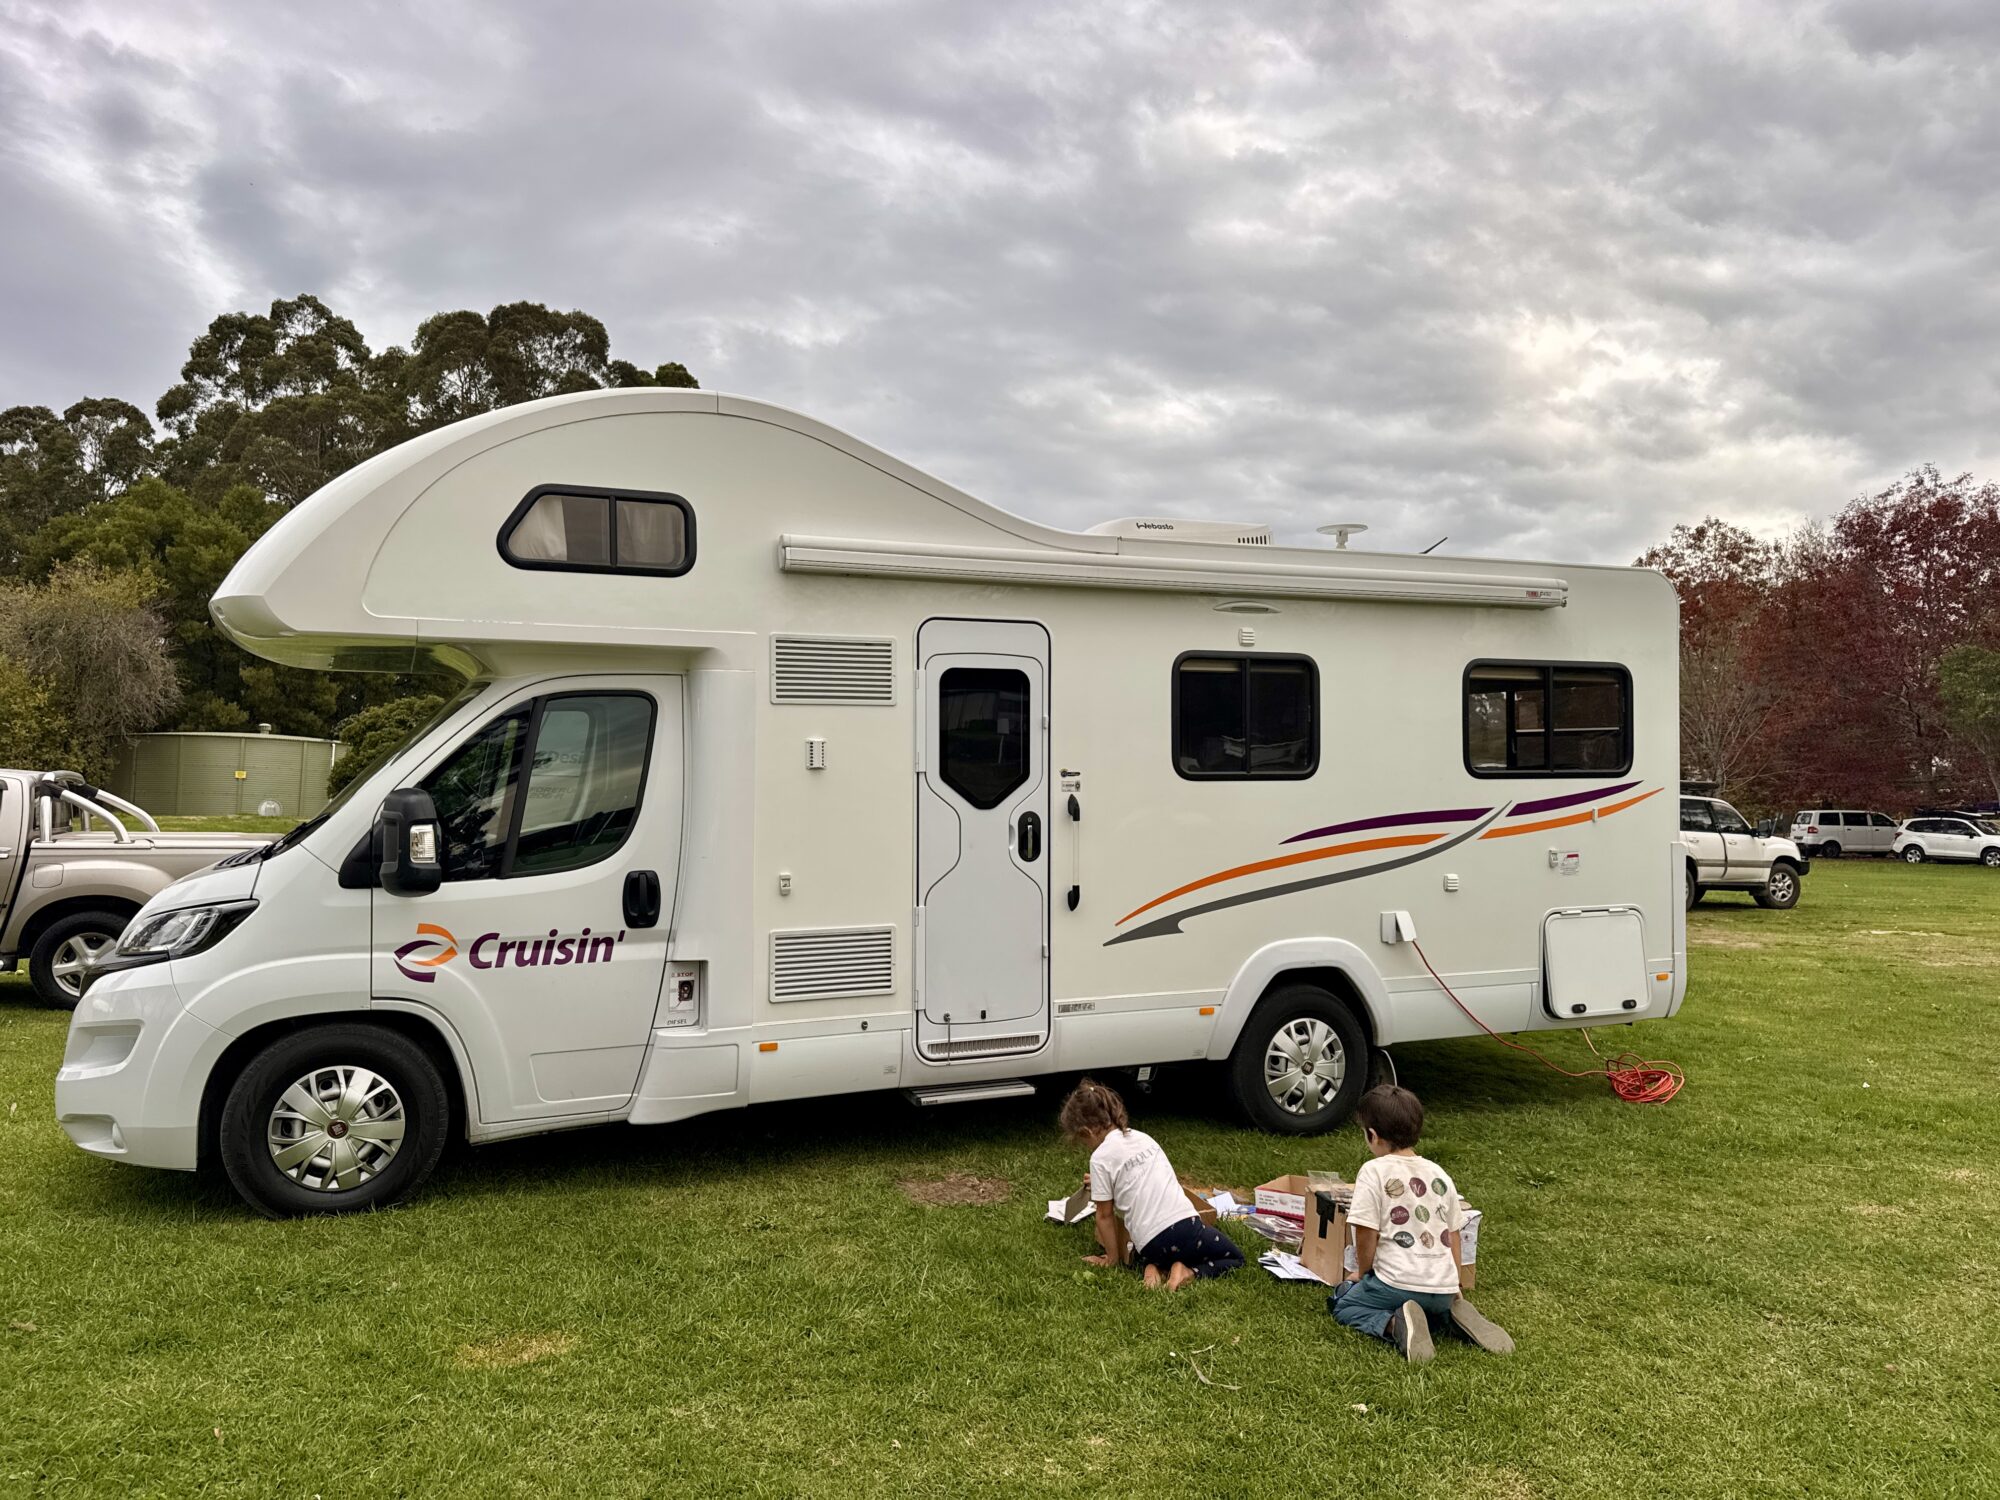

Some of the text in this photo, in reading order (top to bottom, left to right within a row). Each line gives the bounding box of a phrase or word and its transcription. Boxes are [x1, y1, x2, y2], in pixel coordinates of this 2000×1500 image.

[1136, 522, 1174, 530] Webasto
[468, 927, 626, 969] Cruisin'
[667, 1018, 687, 1026] DIESEL
